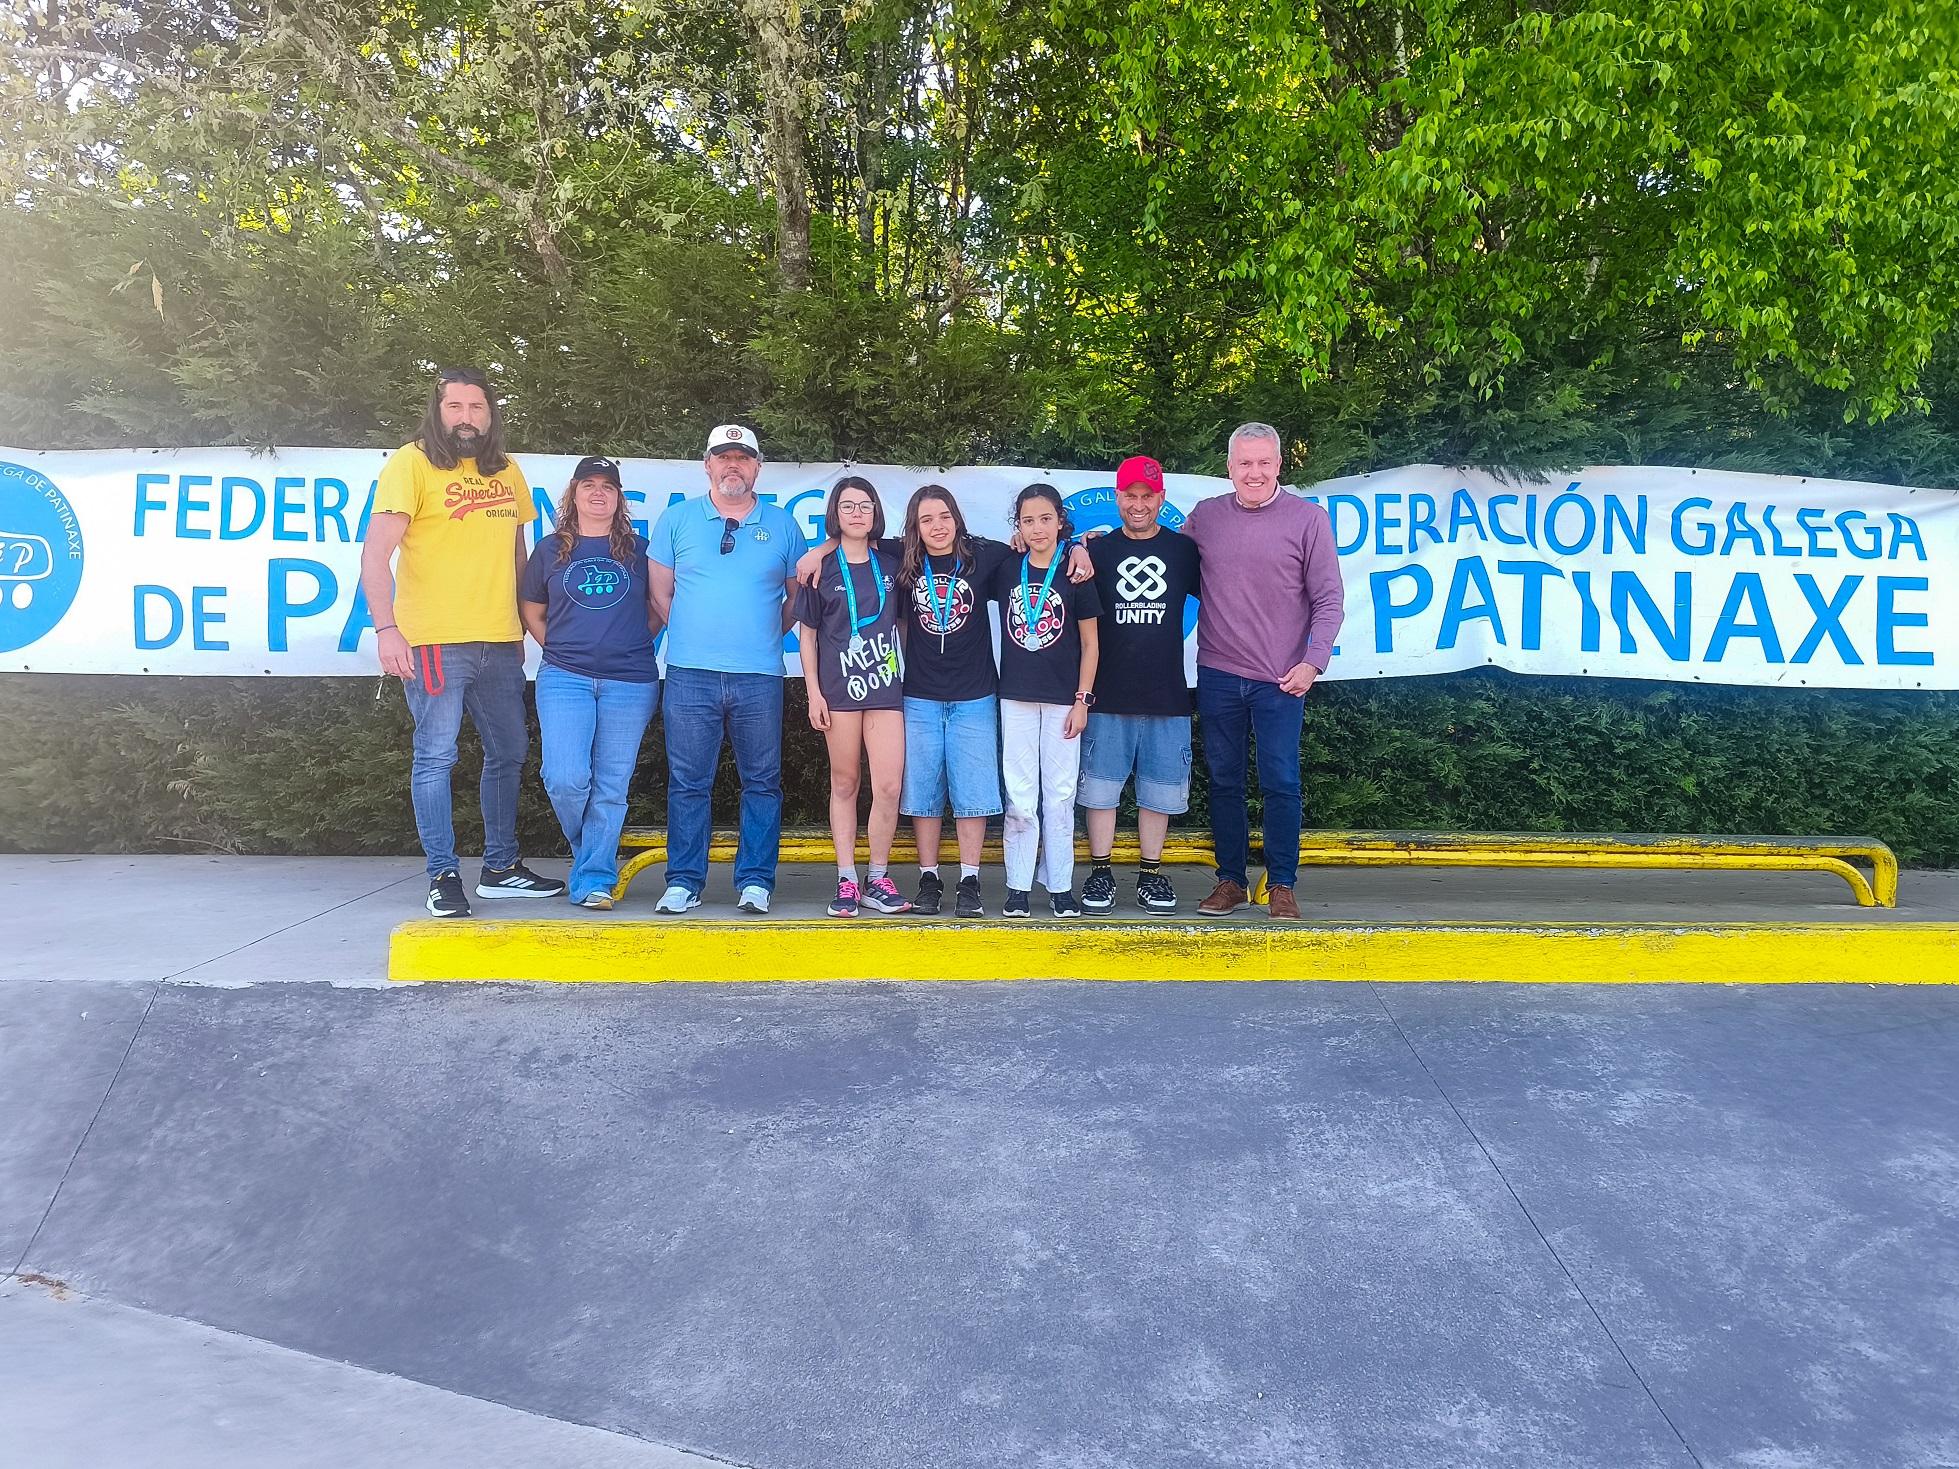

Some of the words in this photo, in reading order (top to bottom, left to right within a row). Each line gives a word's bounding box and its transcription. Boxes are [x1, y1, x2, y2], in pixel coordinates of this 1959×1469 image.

[464, 477, 485, 486] REAL
[25, 474, 47, 493] DE
[44, 488, 82, 560] PATINAXE
[1303, 481, 1647, 556] DERACIÓN
[1670, 496, 1928, 561] GALEGA
[134, 584, 230, 651] DE
[1115, 602, 1167, 610] ROLLERBLADING
[1115, 609, 1166, 625] UNITY
[1369, 556, 1935, 666] PATINAXE
